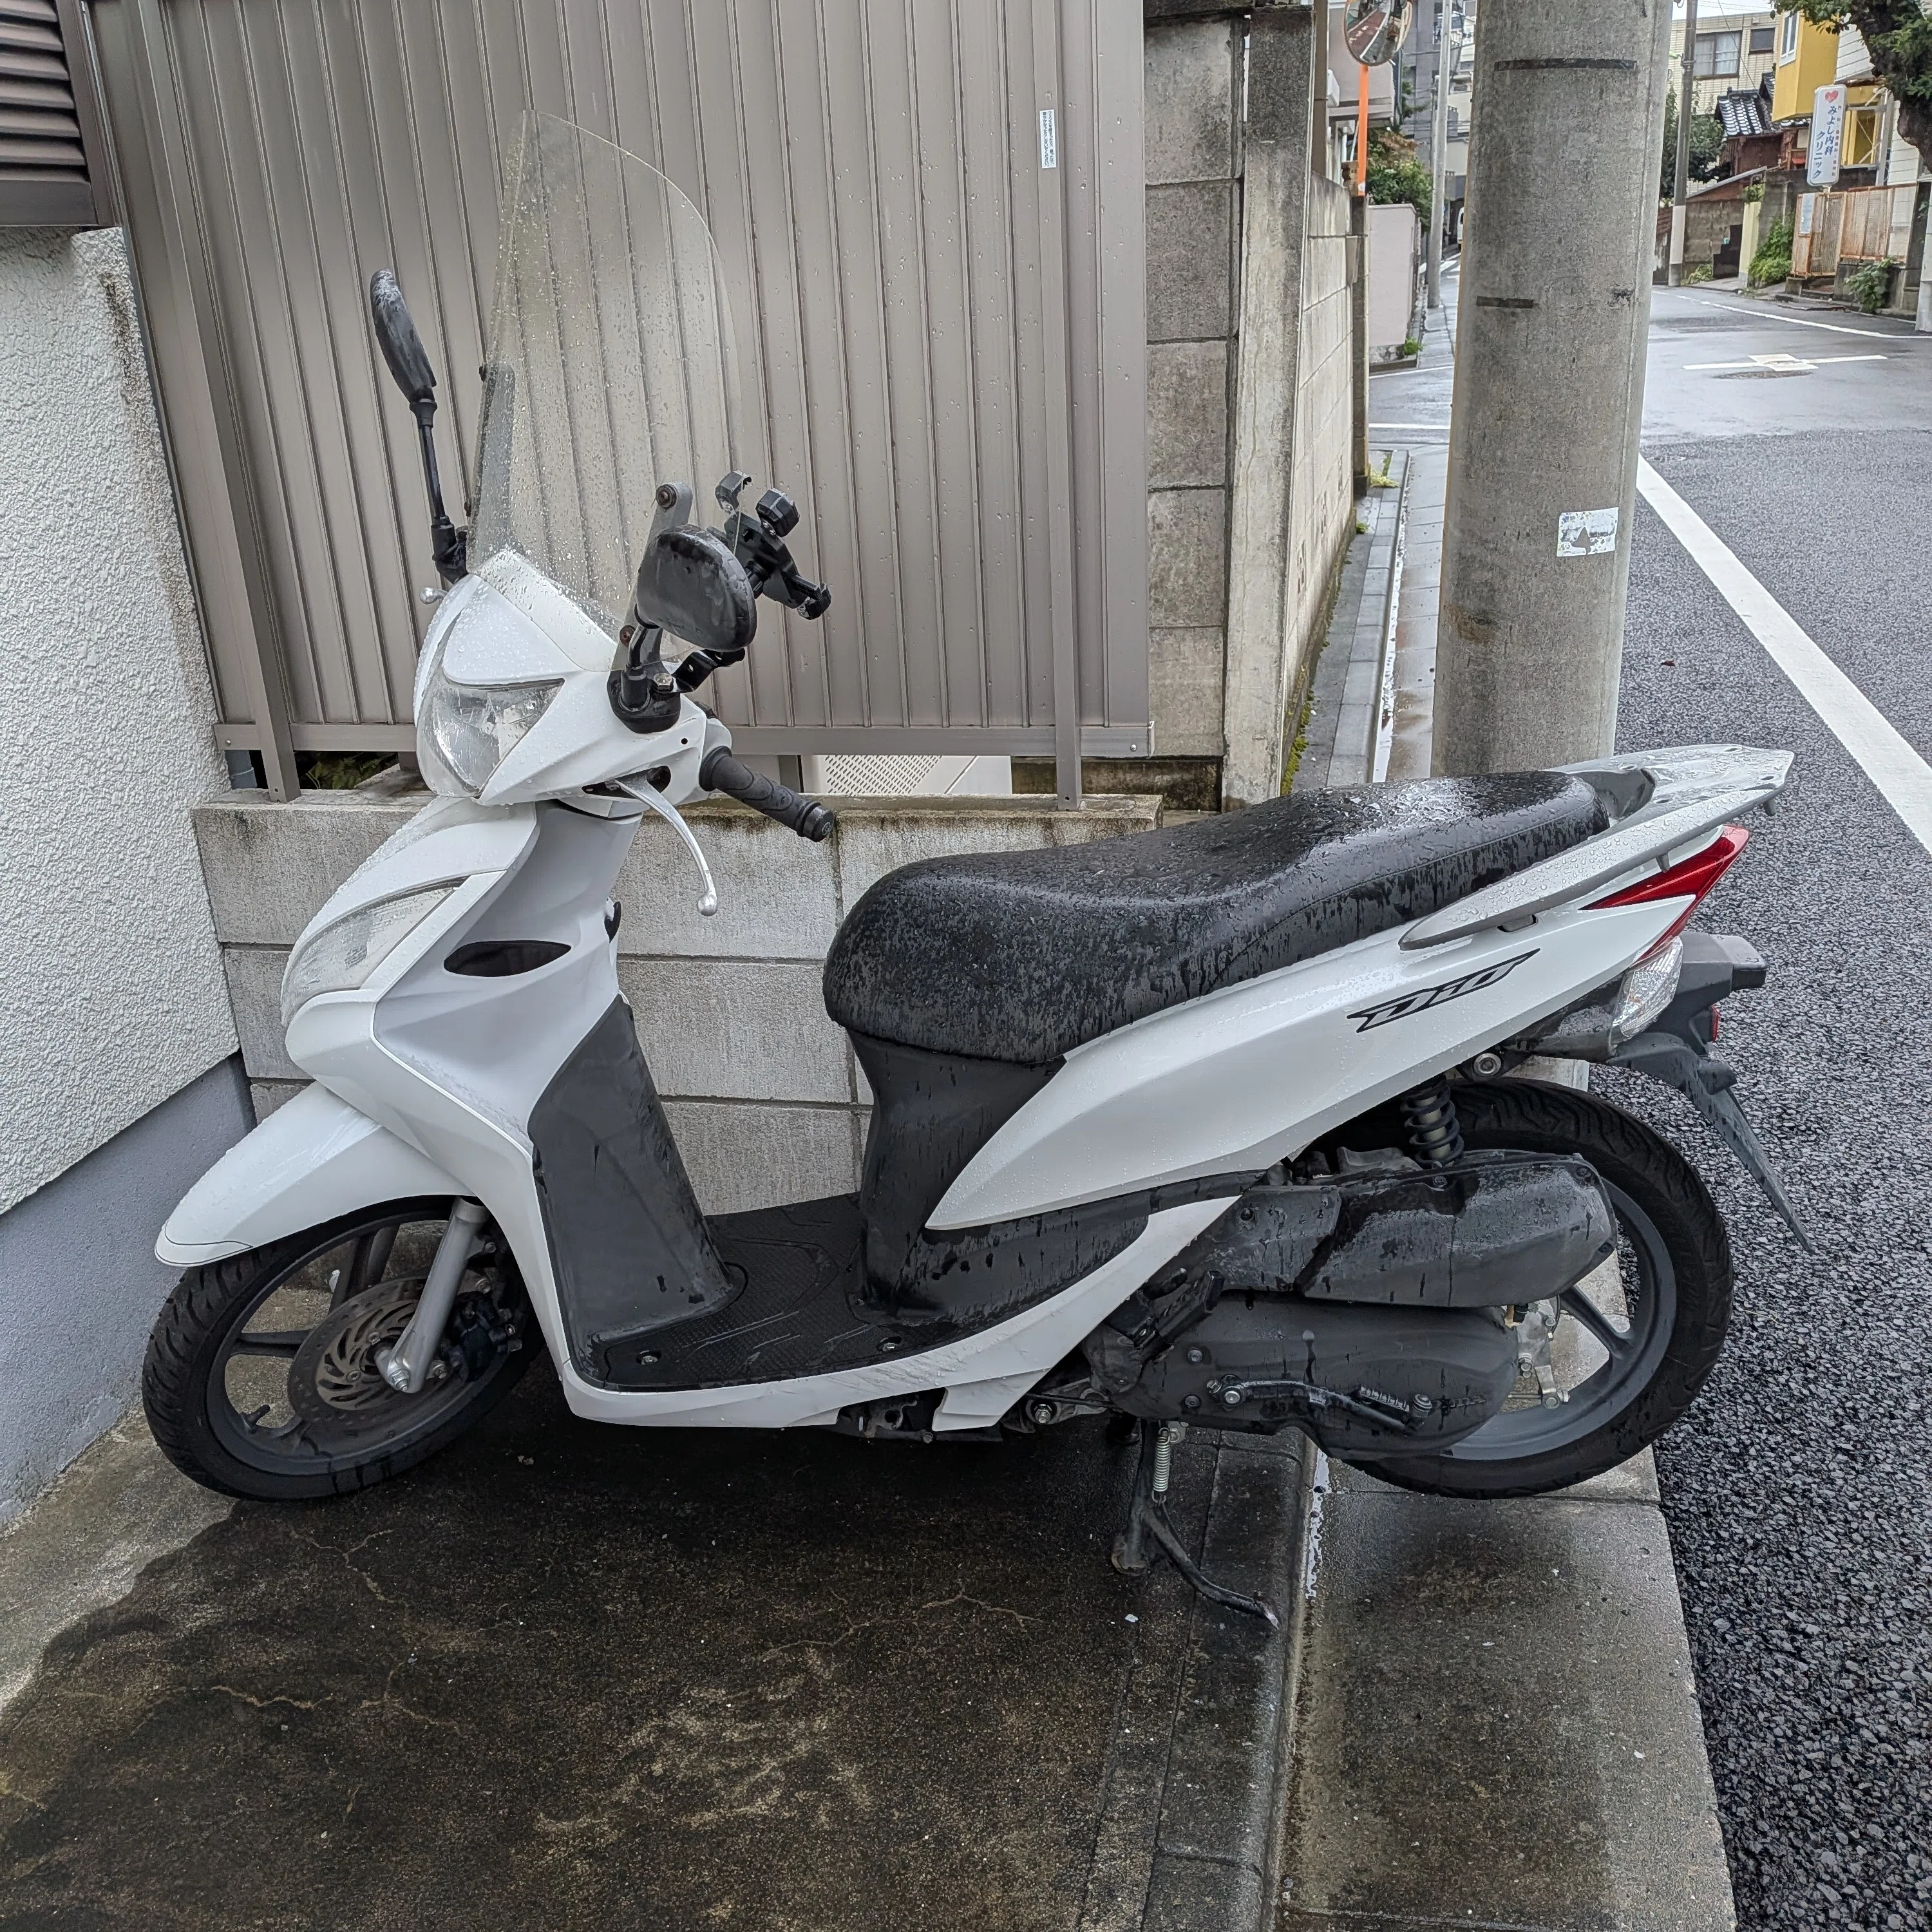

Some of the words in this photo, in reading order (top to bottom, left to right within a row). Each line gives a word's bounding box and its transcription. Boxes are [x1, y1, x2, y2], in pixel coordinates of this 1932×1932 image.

[1812, 131, 1825, 178] クリニック
[1824, 106, 1837, 156] みよし内科
